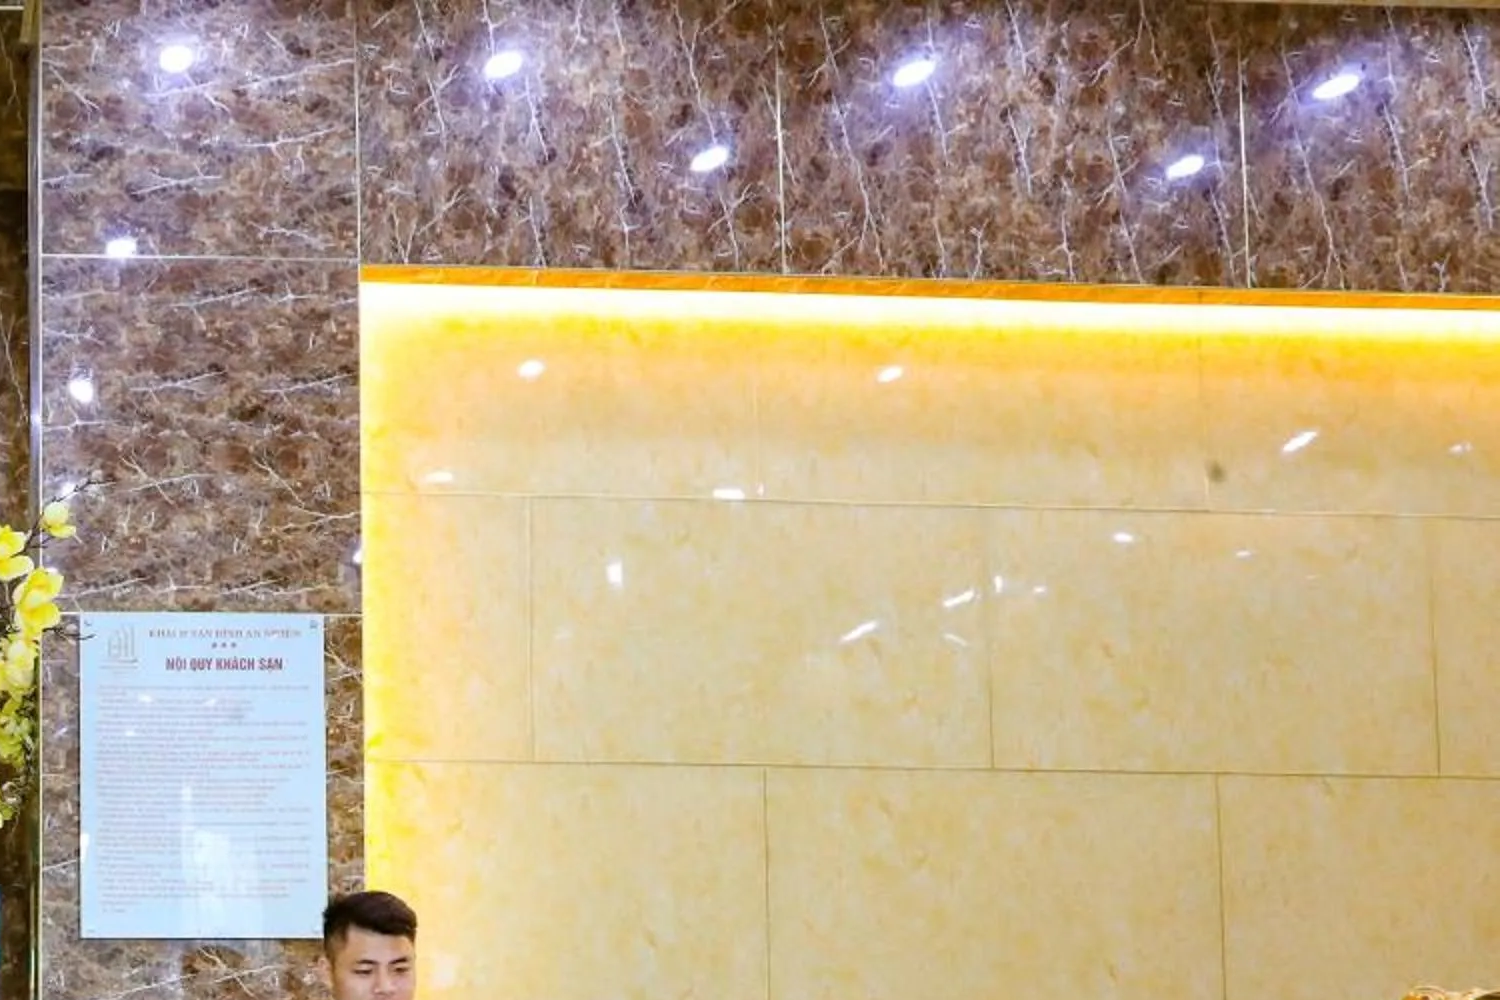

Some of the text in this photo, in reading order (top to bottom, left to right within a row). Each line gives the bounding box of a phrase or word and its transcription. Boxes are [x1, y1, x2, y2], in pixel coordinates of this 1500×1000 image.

[190, 658, 213, 672] QUY
[215, 655, 255, 671] KHÁCH
[258, 658, 283, 673] SẠN
